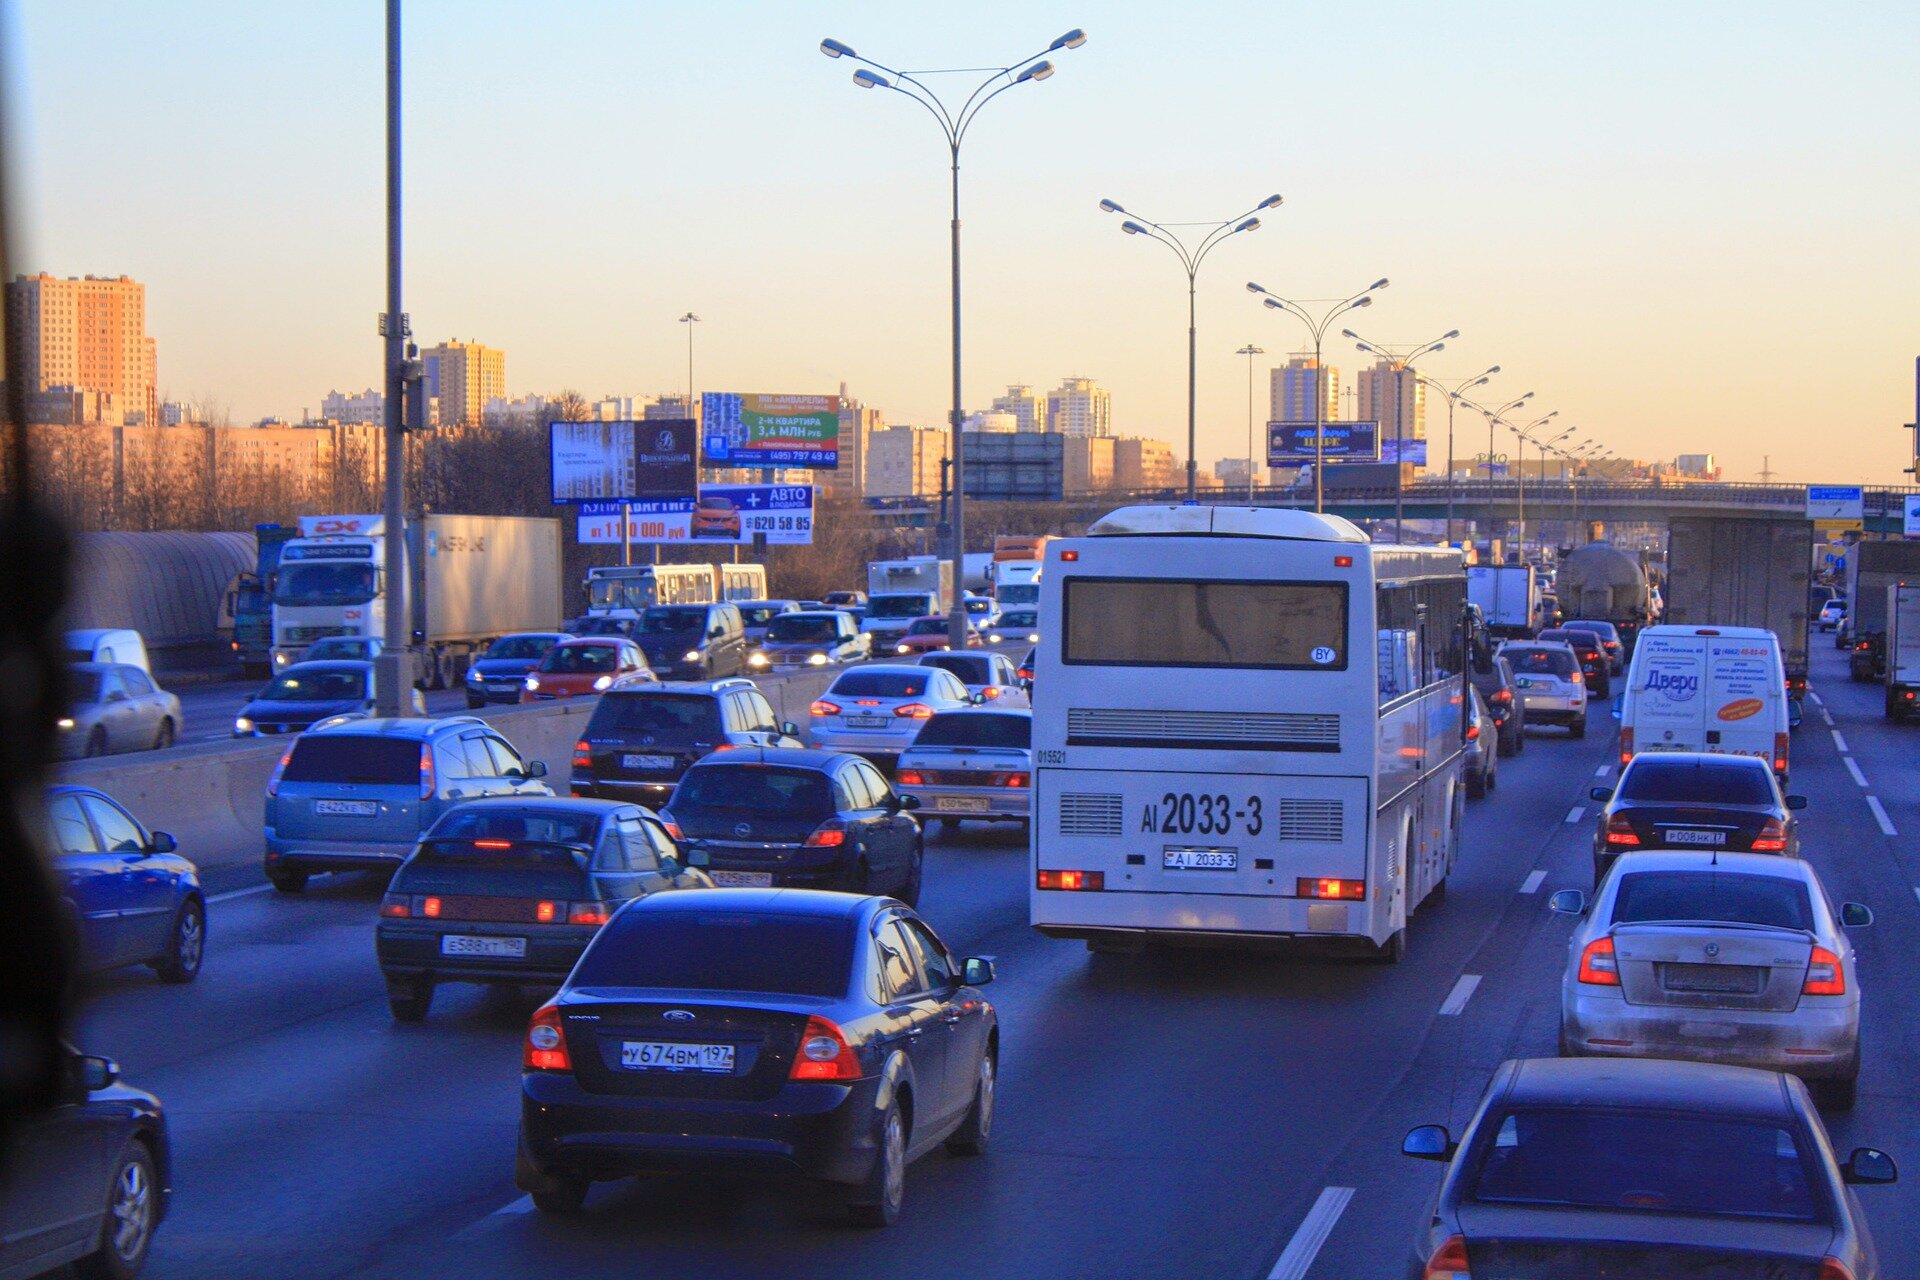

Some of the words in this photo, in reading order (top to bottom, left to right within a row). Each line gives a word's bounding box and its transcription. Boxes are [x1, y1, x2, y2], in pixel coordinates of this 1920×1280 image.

[775, 417, 822, 426] КВАРТИРА
[758, 426, 776, 437] 3,4
[779, 426, 806, 436] МЛН
[770, 450, 792, 460] (495)
[792, 451, 809, 460] 797
[811, 451, 823, 460] 49
[824, 452, 836, 461] 49
[769, 487, 807, 501] АВТО
[754, 516, 776, 530] 620
[778, 516, 793, 530] 58
[795, 516, 811, 530] 85
[668, 526, 686, 539] руб
[1315, 648, 1331, 660] BY
[1644, 669, 1699, 695] Двери
[1037, 750, 1067, 764] 015521
[1140, 804, 1158, 834] AI
[1161, 792, 1263, 837] 2033-3
[1195, 853, 1236, 867] 2033-3
[629, 1044, 700, 1065] У674ВМ
[702, 1045, 730, 1061] 197
